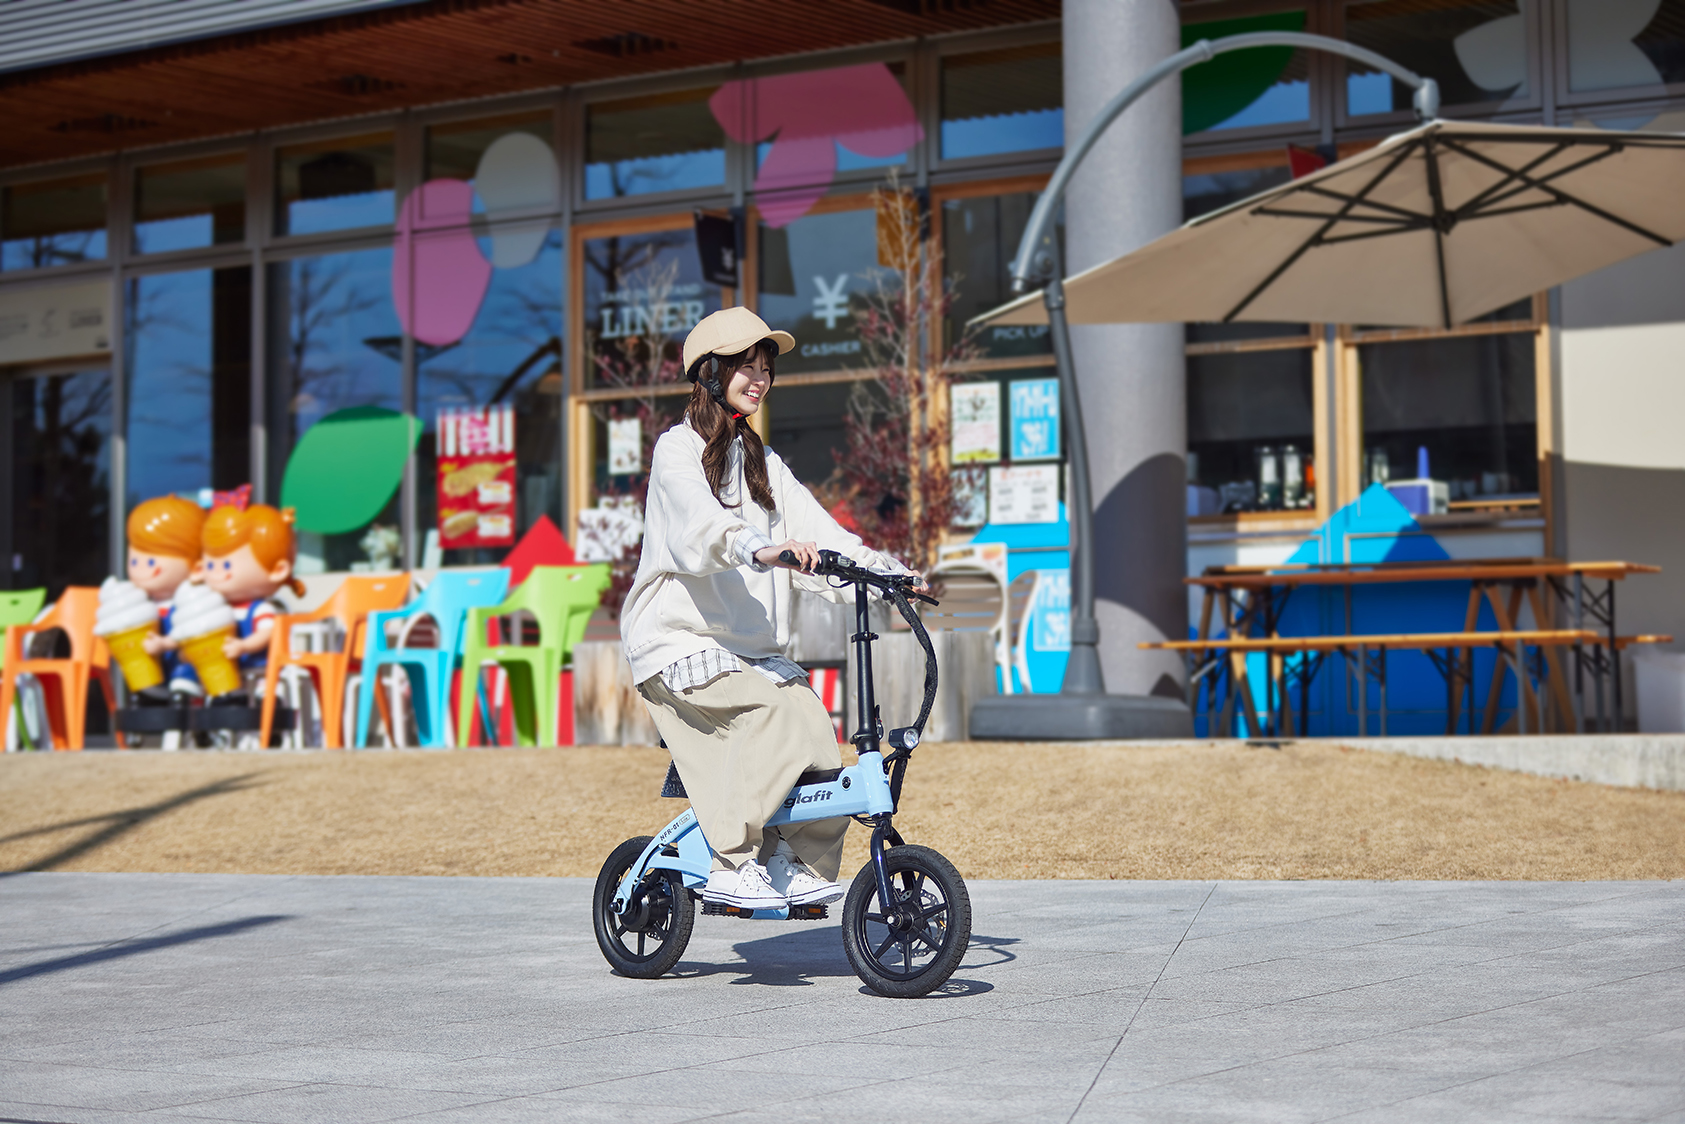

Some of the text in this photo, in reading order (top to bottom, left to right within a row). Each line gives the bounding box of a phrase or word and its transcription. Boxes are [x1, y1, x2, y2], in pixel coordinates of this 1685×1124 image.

[812, 273, 849, 329] ¥
[600, 301, 704, 339] LINER
[801, 341, 861, 357] CASHIER
[783, 790, 833, 808] glafit
